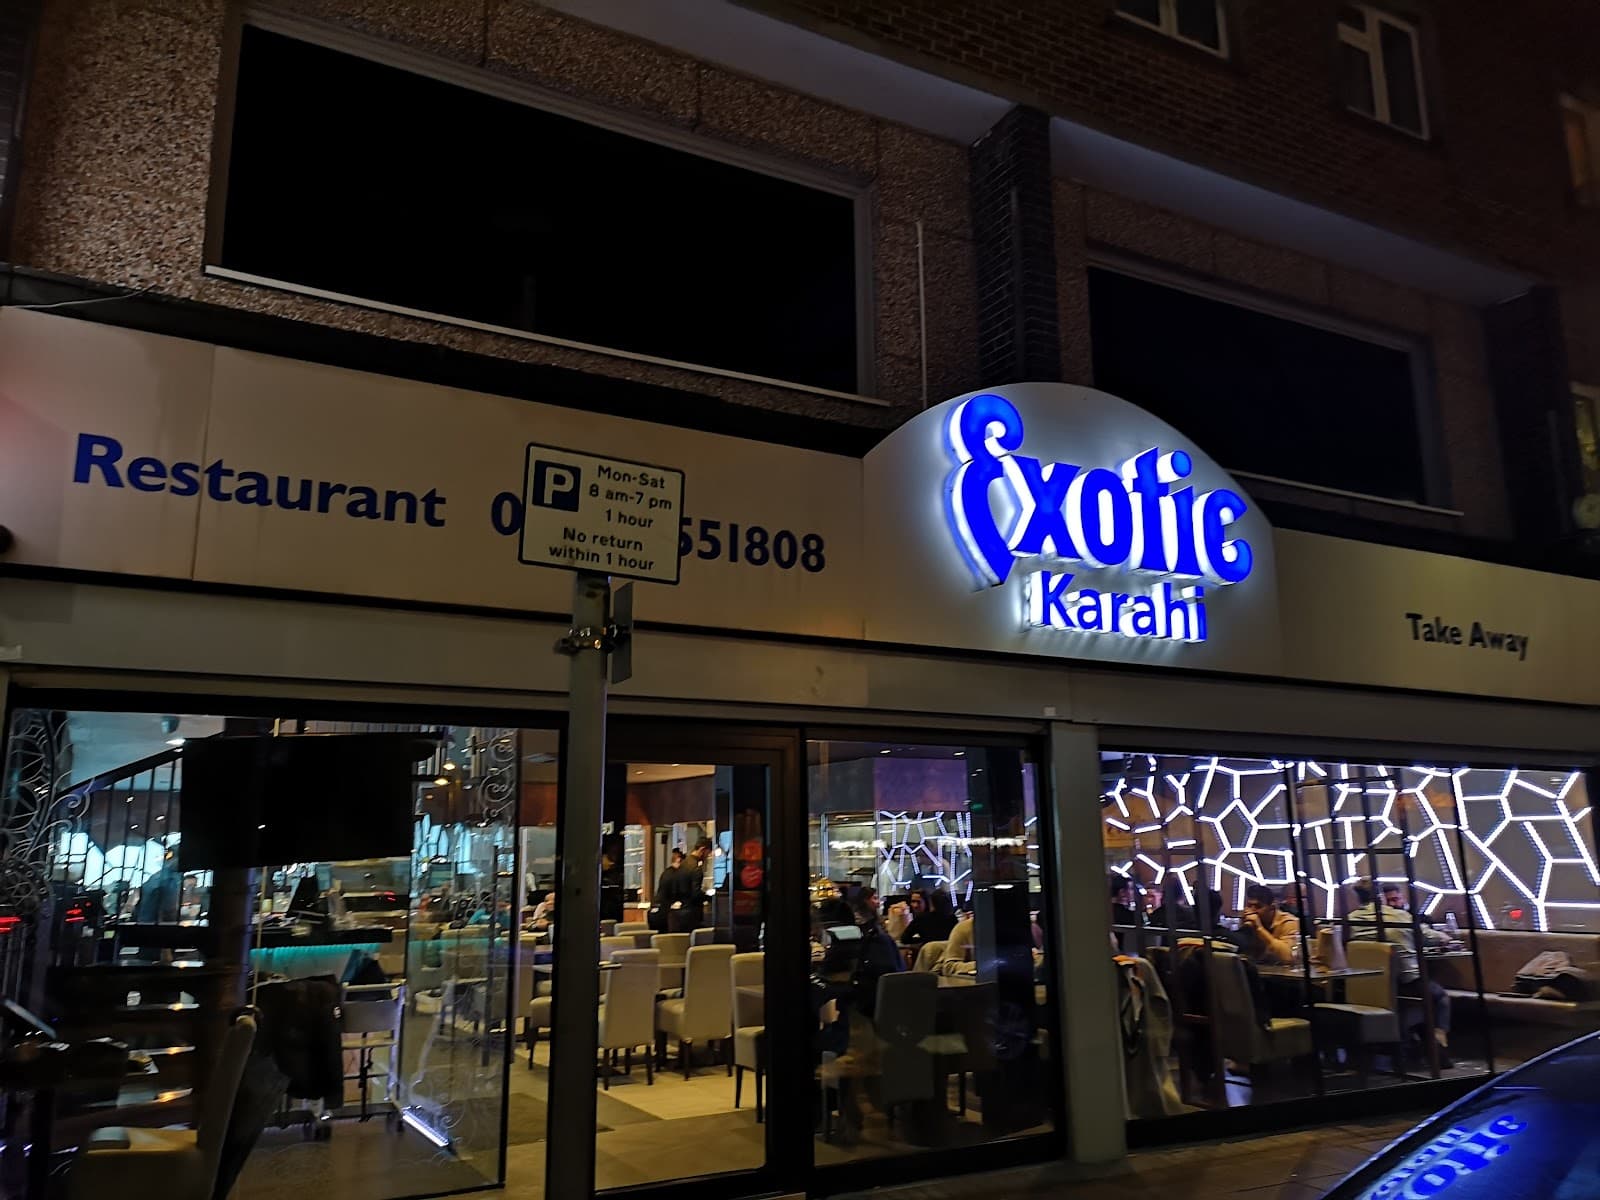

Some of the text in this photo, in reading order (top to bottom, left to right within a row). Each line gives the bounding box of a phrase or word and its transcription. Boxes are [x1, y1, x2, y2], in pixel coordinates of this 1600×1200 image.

[72, 432, 447, 527] Restaurant
[543, 466, 575, 504] P
[597, 465, 665, 489] Mon-Sat
[952, 394, 1252, 587] Exotic
[589, 483, 672, 510] 8 am-7 pm
[605, 508, 654, 528] 1 hour
[563, 527, 643, 551] No return
[548, 545, 655, 570] within 1 hour
[1032, 570, 1207, 643] Karahi
[1405, 612, 1528, 661] Take Away
